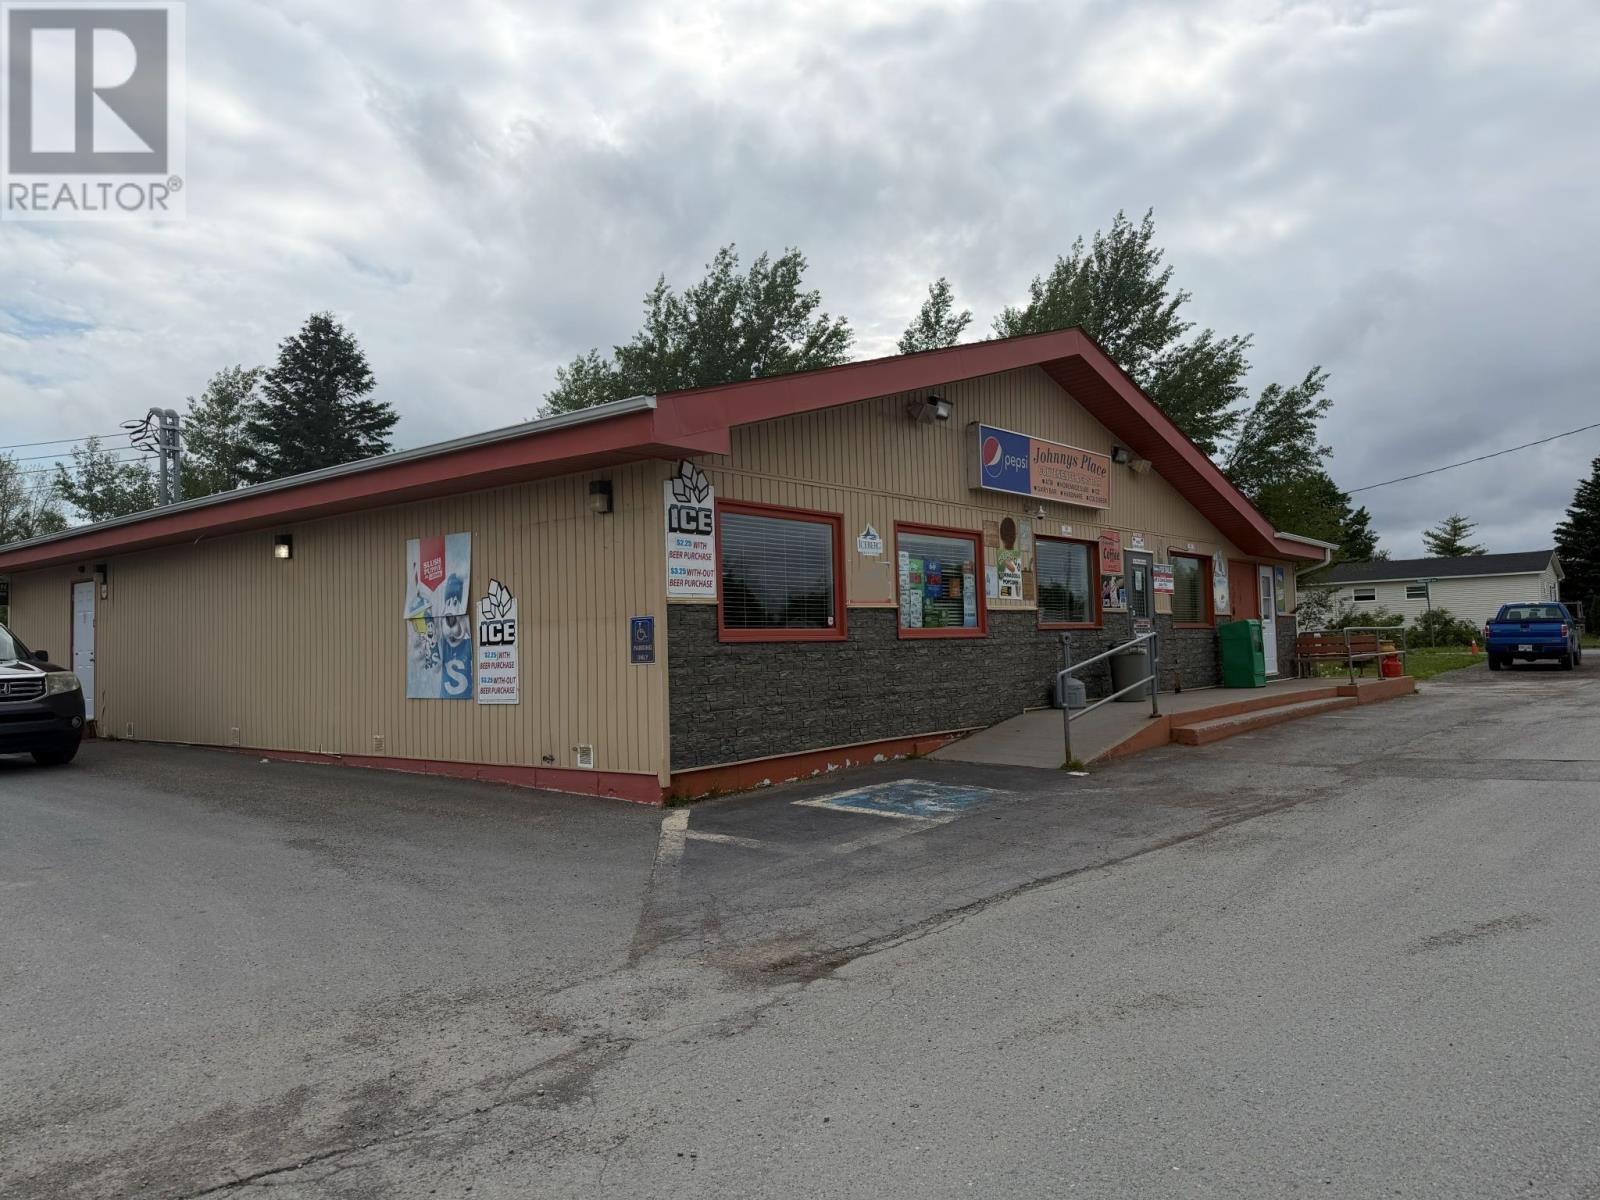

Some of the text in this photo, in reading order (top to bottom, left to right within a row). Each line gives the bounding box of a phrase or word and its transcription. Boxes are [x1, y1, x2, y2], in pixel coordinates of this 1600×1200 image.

[1004, 455, 1028, 473] pepsi
[1033, 447, 1078, 470] Johnnys
[1080, 454, 1107, 478] Place
[668, 504, 713, 536] ICE
[693, 541, 707, 550] WITH
[669, 550, 713, 561] BEER PURCHASE
[686, 568, 714, 578] WITH-OUT
[669, 578, 713, 588] BEER PURCHASE
[480, 619, 516, 647] ICE
[498, 651, 511, 659] WITH
[480, 661, 515, 670] BEER PURCHASE
[444, 660, 469, 695] S
[480, 686, 516, 695] BEER PURCHASE
